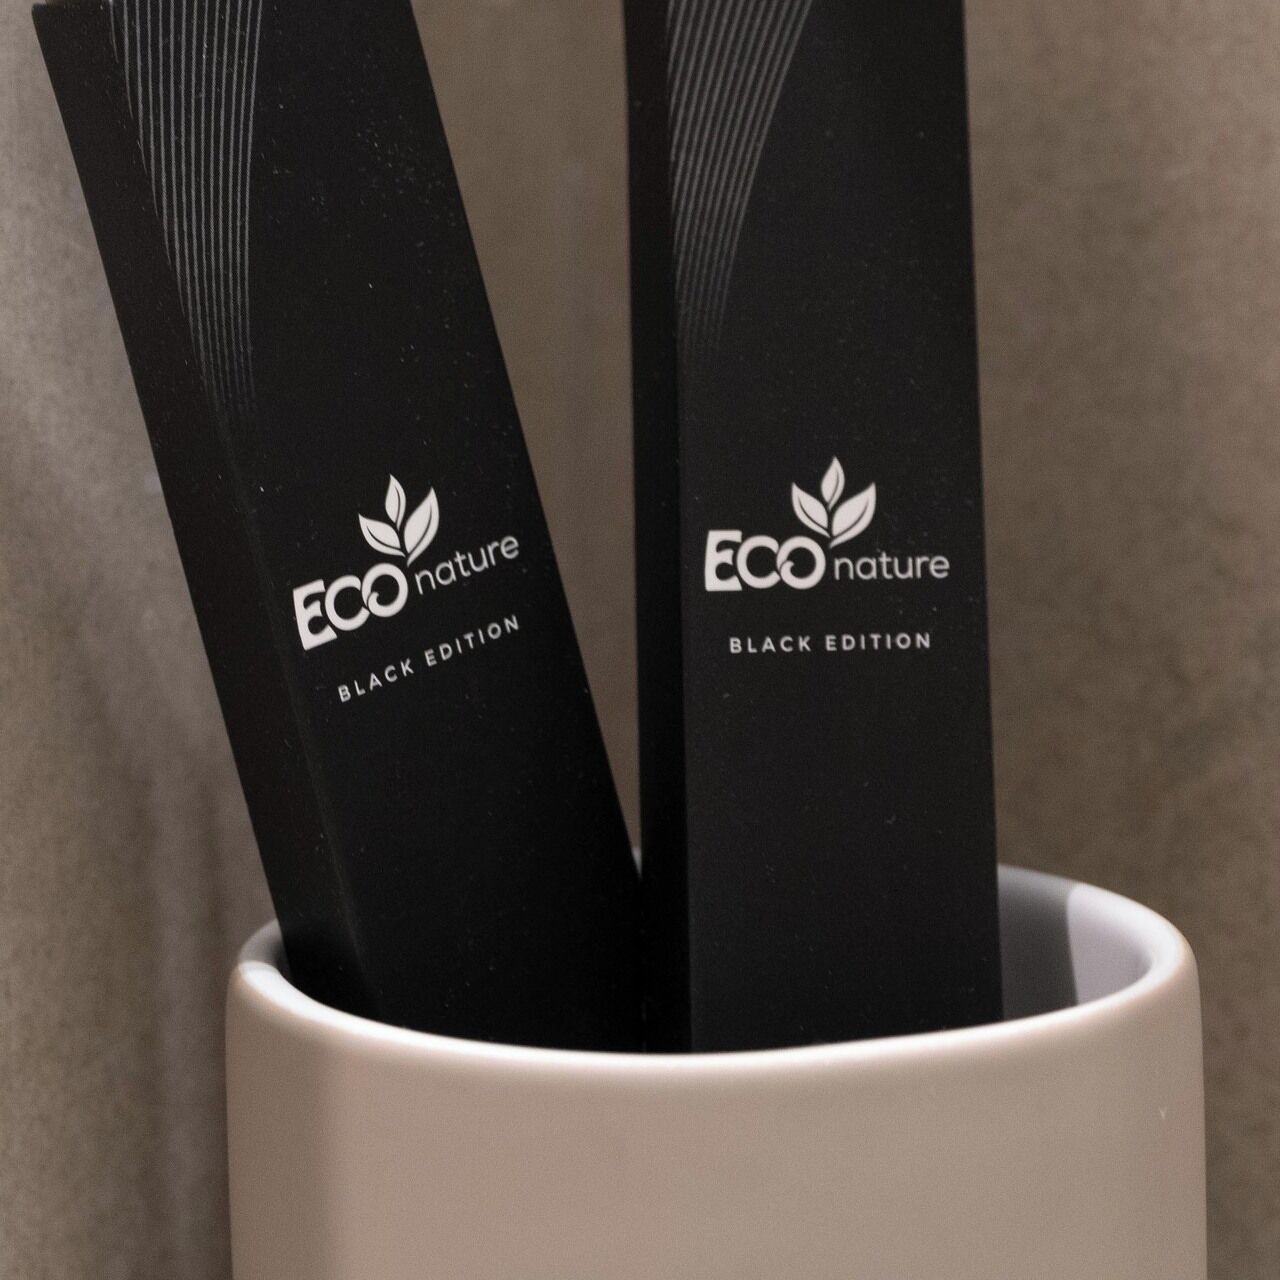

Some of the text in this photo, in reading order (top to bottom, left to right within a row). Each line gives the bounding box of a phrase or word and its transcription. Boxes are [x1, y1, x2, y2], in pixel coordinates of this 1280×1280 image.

[292, 531, 519, 651] ECO nature
[704, 529, 950, 592] ECO nature
[338, 615, 520, 703] BLACK EDITION
[729, 633, 931, 654] BLACK EDITION
